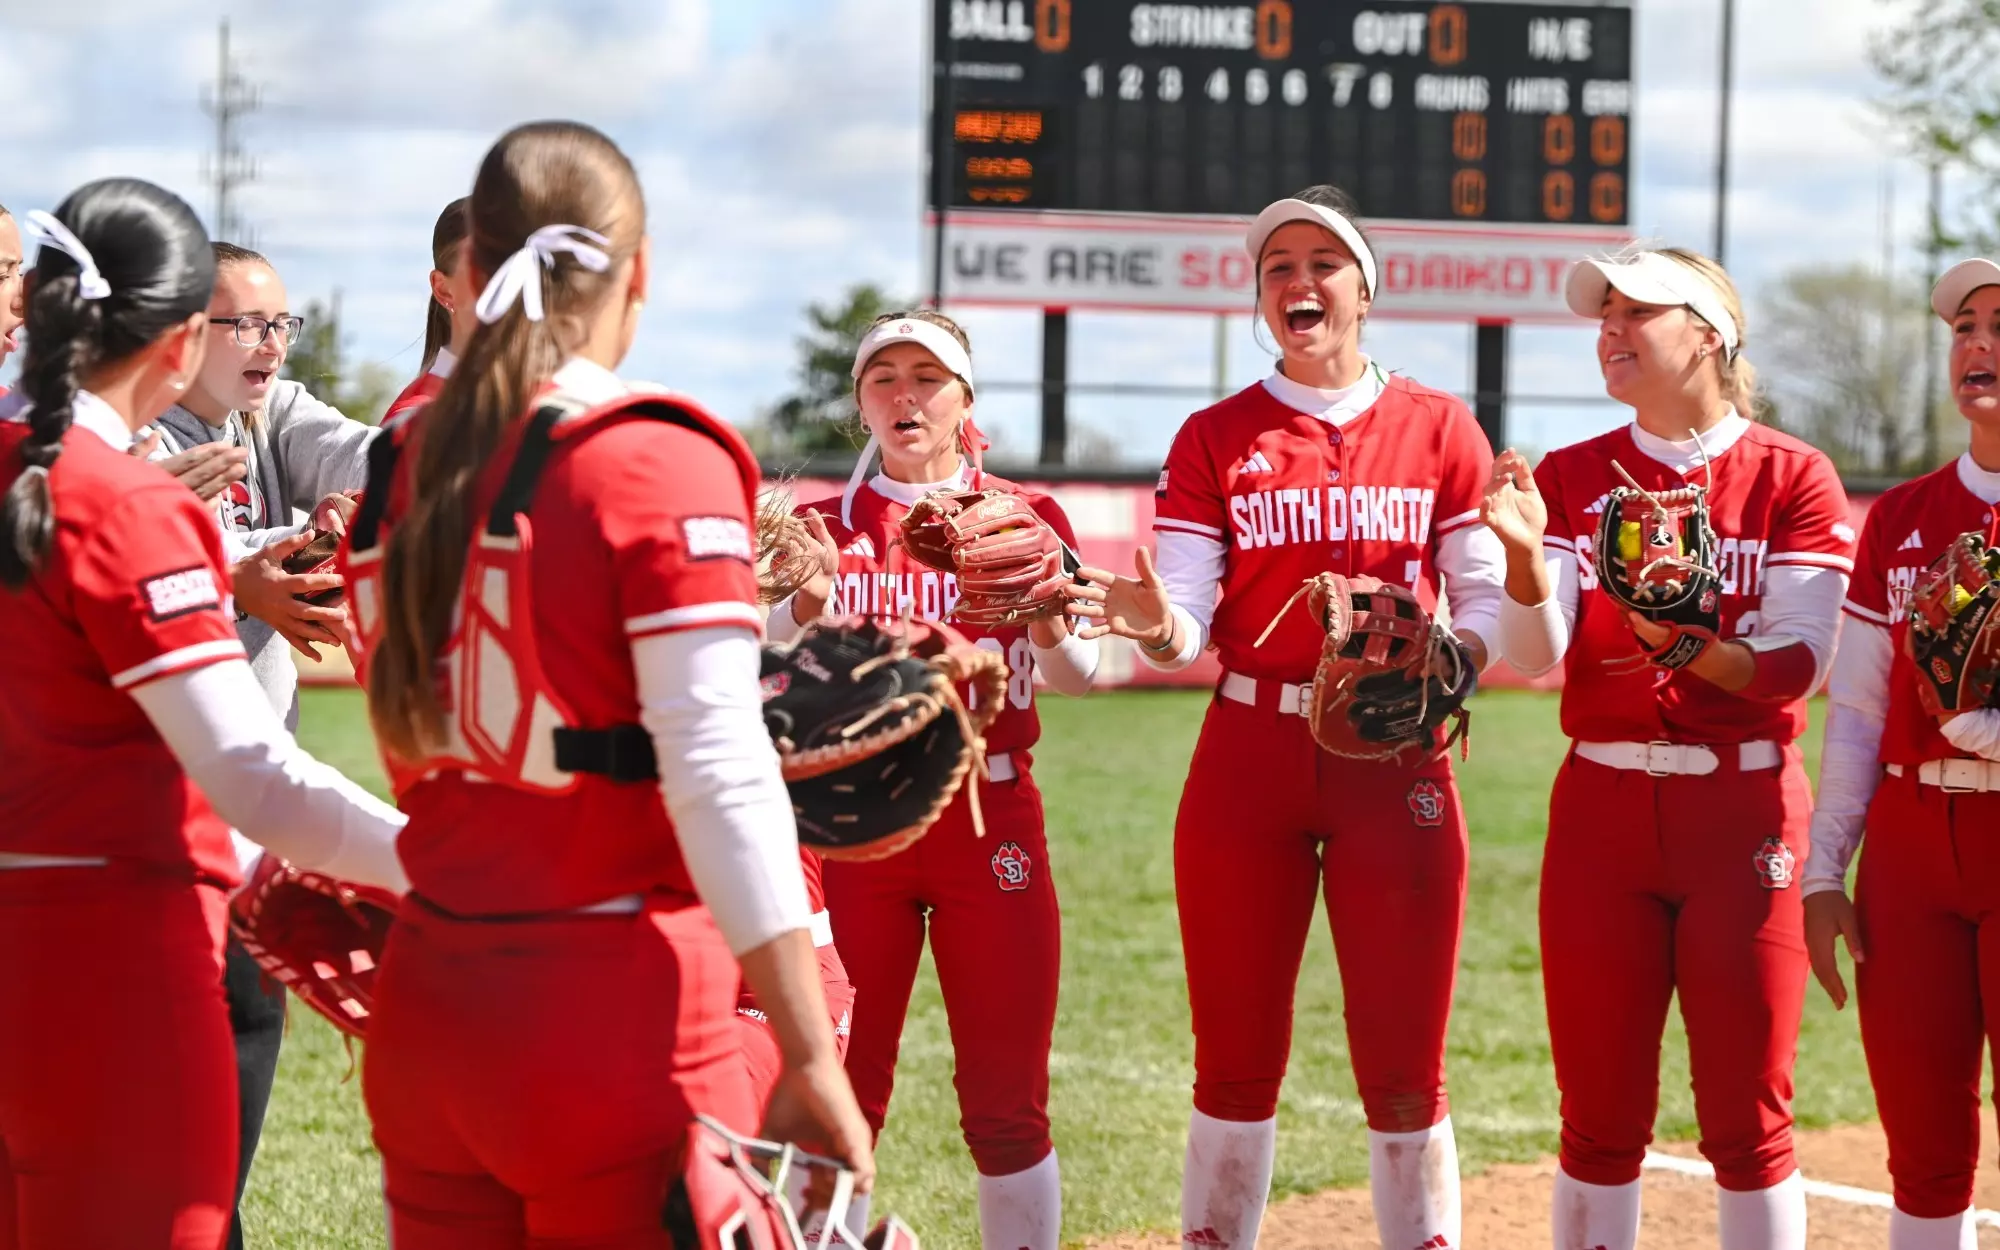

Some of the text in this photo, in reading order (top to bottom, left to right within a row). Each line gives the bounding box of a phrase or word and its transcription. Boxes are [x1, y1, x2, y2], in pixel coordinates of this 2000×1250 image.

[1034, 0, 1071, 53] 0
[1131, 0, 1292, 60] STRIKE 0
[1353, 5, 1467, 67] OUT 0
[1082, 62, 1104, 98] 1
[1119, 64, 1143, 100] 2
[1157, 66, 1183, 102] 3
[1204, 67, 1229, 103] 4
[1245, 68, 1269, 105] 5
[1282, 68, 1307, 106] 6
[1327, 62, 1366, 107] 7
[1415, 74, 1490, 111] RUNS
[1506, 77, 1569, 114] HITS
[1453, 111, 1624, 167] 0 0 0
[1543, 169, 1575, 220] 0
[1589, 171, 1623, 222] 0
[1048, 246, 1163, 288] ARE
[1383, 253, 1572, 295] DAKOT
[1230, 486, 1435, 550] SOUTH DAKOTA
